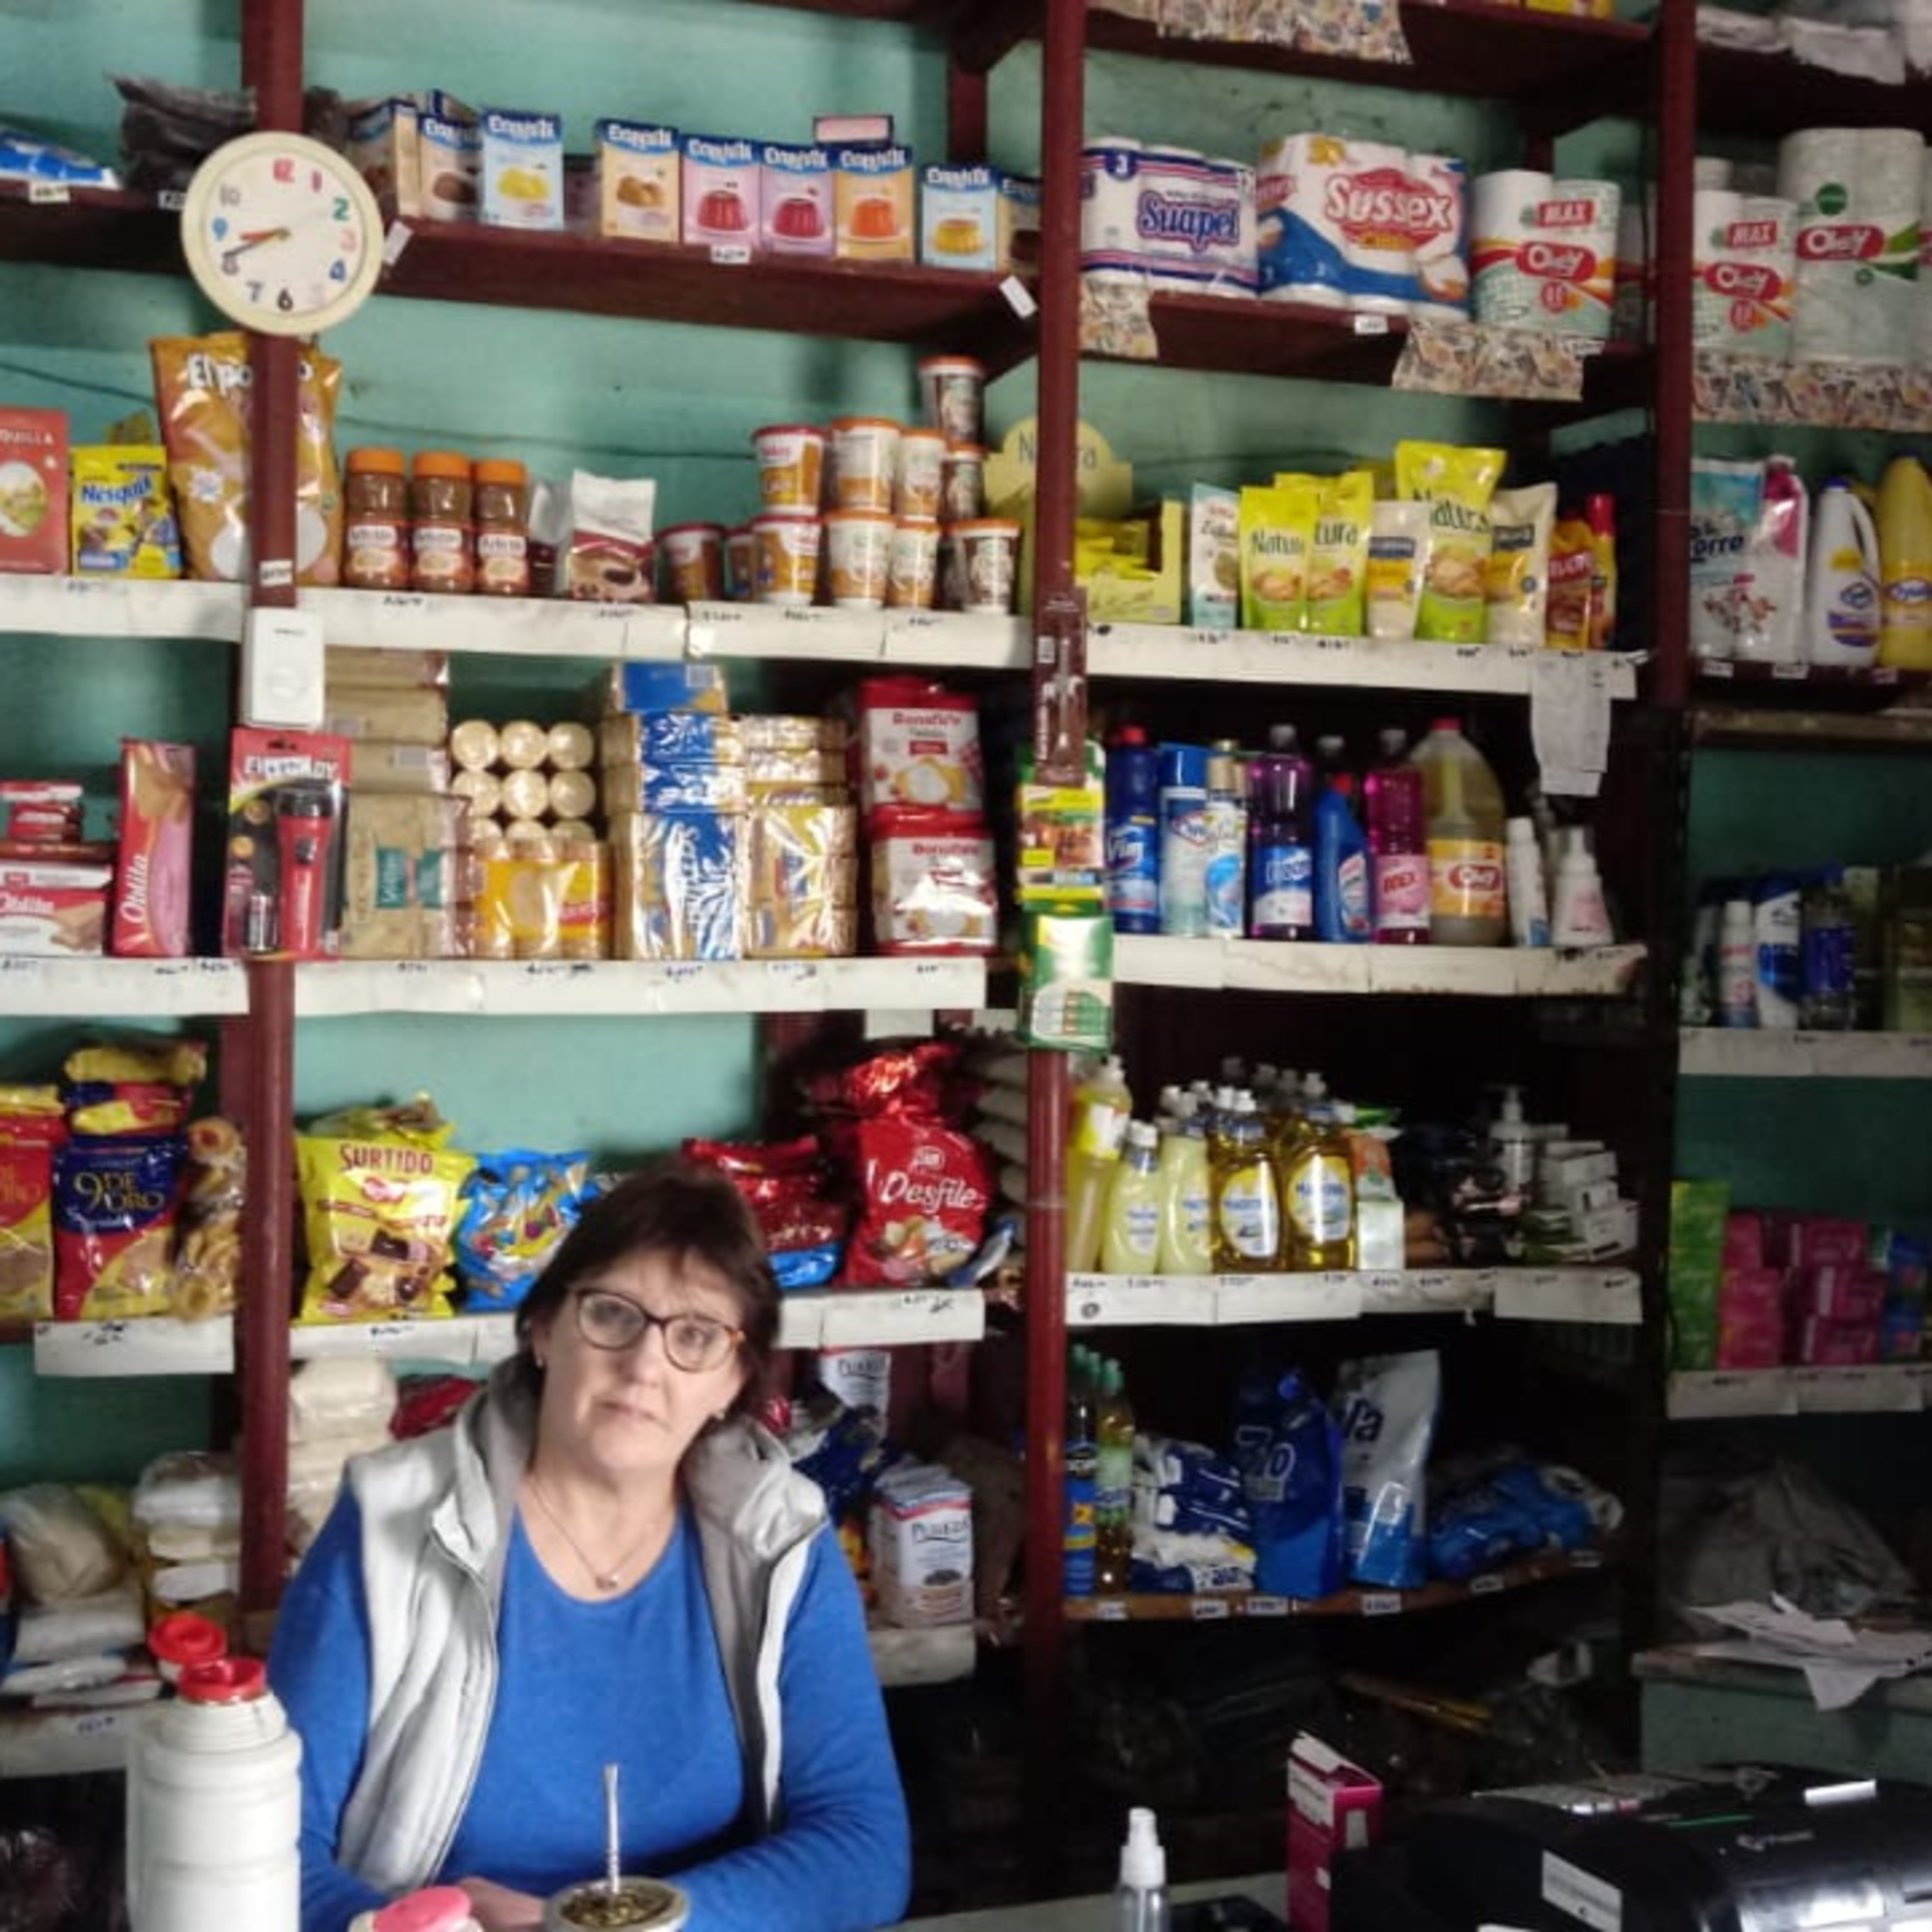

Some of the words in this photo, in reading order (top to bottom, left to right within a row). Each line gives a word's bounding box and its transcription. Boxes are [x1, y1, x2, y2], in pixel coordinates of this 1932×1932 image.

[332, 198, 349, 221] 2
[1325, 174, 1454, 228] Sussex
[329, 260, 346, 281] 4
[246, 281, 263, 302] 7
[277, 289, 293, 312] 6
[340, 1144, 434, 1173] SURTIDO
[880, 1171, 978, 1213] Desfile
